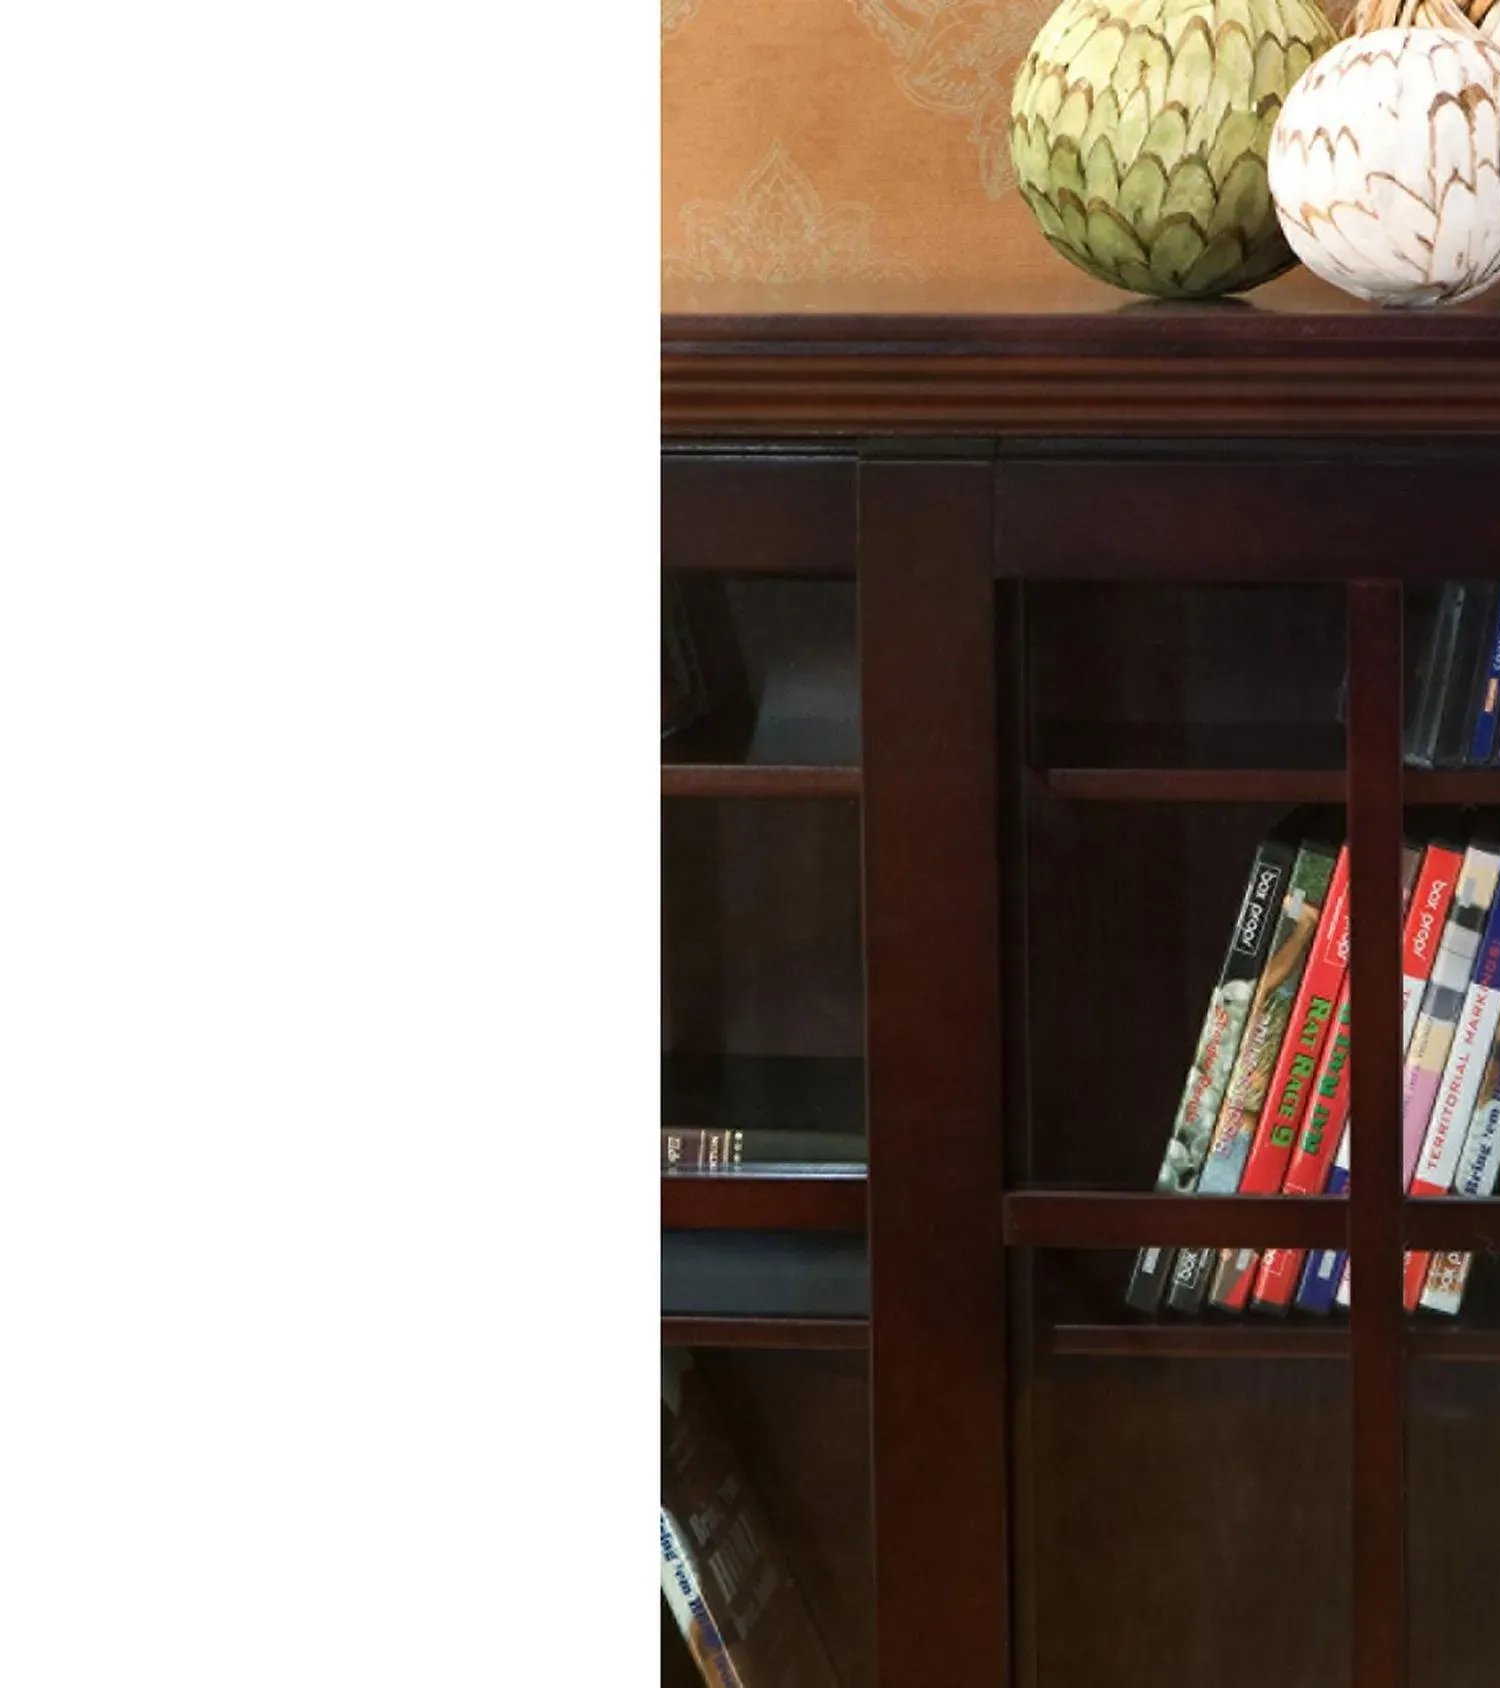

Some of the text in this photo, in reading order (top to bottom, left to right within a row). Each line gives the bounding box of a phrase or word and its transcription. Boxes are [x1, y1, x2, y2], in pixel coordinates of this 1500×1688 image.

[1256, 869, 1278, 900] box
[1427, 879, 1447, 914] box
[1269, 994, 1333, 1149] RAT RACE 9
[1426, 1053, 1471, 1171] TERRITORIAL
[1463, 1144, 1494, 1196] Bring
[1177, 1251, 1199, 1283] box
